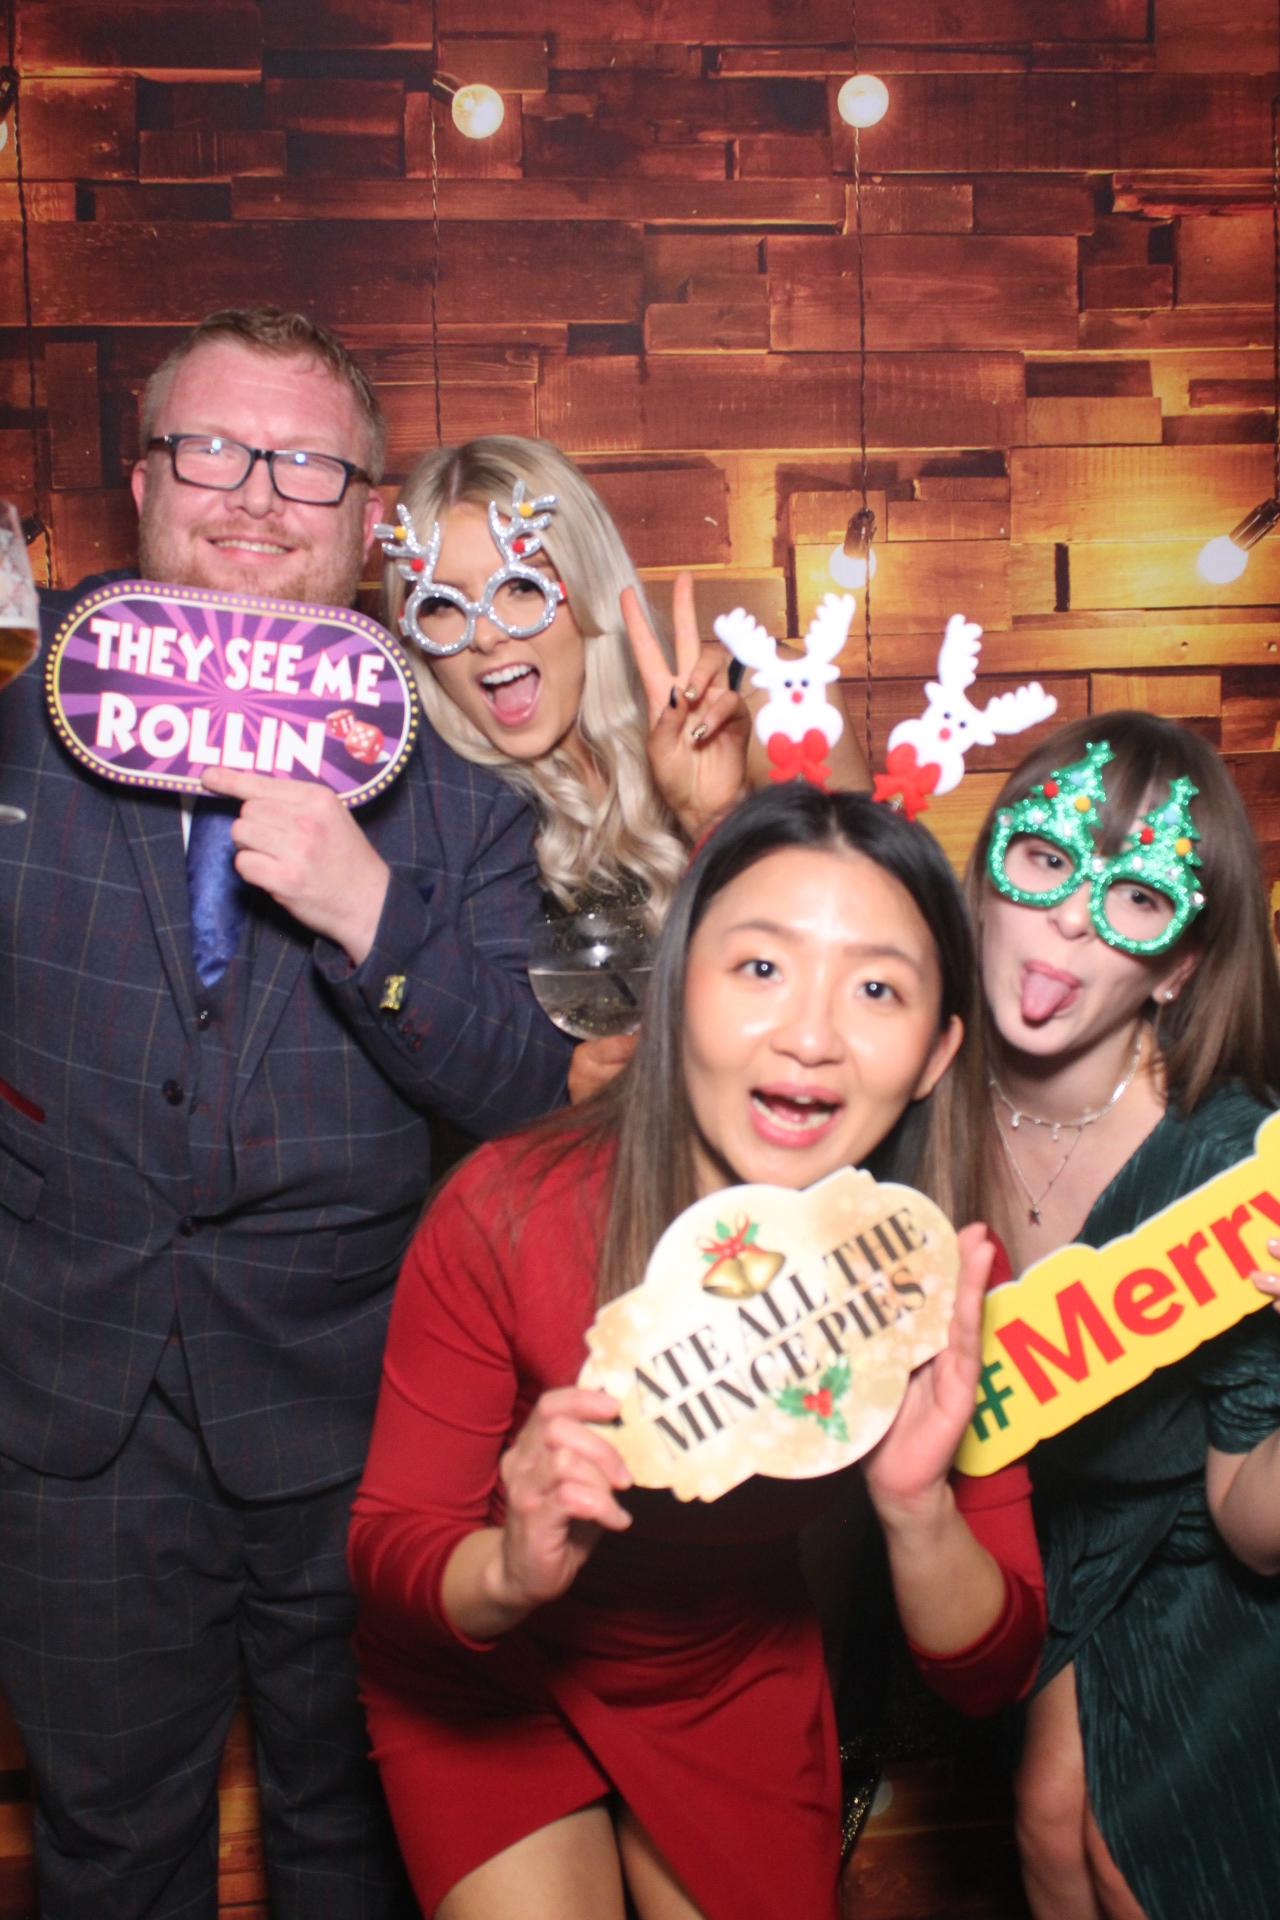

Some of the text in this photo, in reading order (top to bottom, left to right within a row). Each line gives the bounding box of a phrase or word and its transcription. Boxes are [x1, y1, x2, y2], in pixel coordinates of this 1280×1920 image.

[90, 617, 385, 707] THEY SEE ME
[95, 692, 327, 777] ROLLIN
[633, 1325, 731, 1416] ATE
[737, 1272, 829, 1357] ALL
[822, 1206, 928, 1287] THE
[654, 1266, 928, 1460] MINCE PIES
